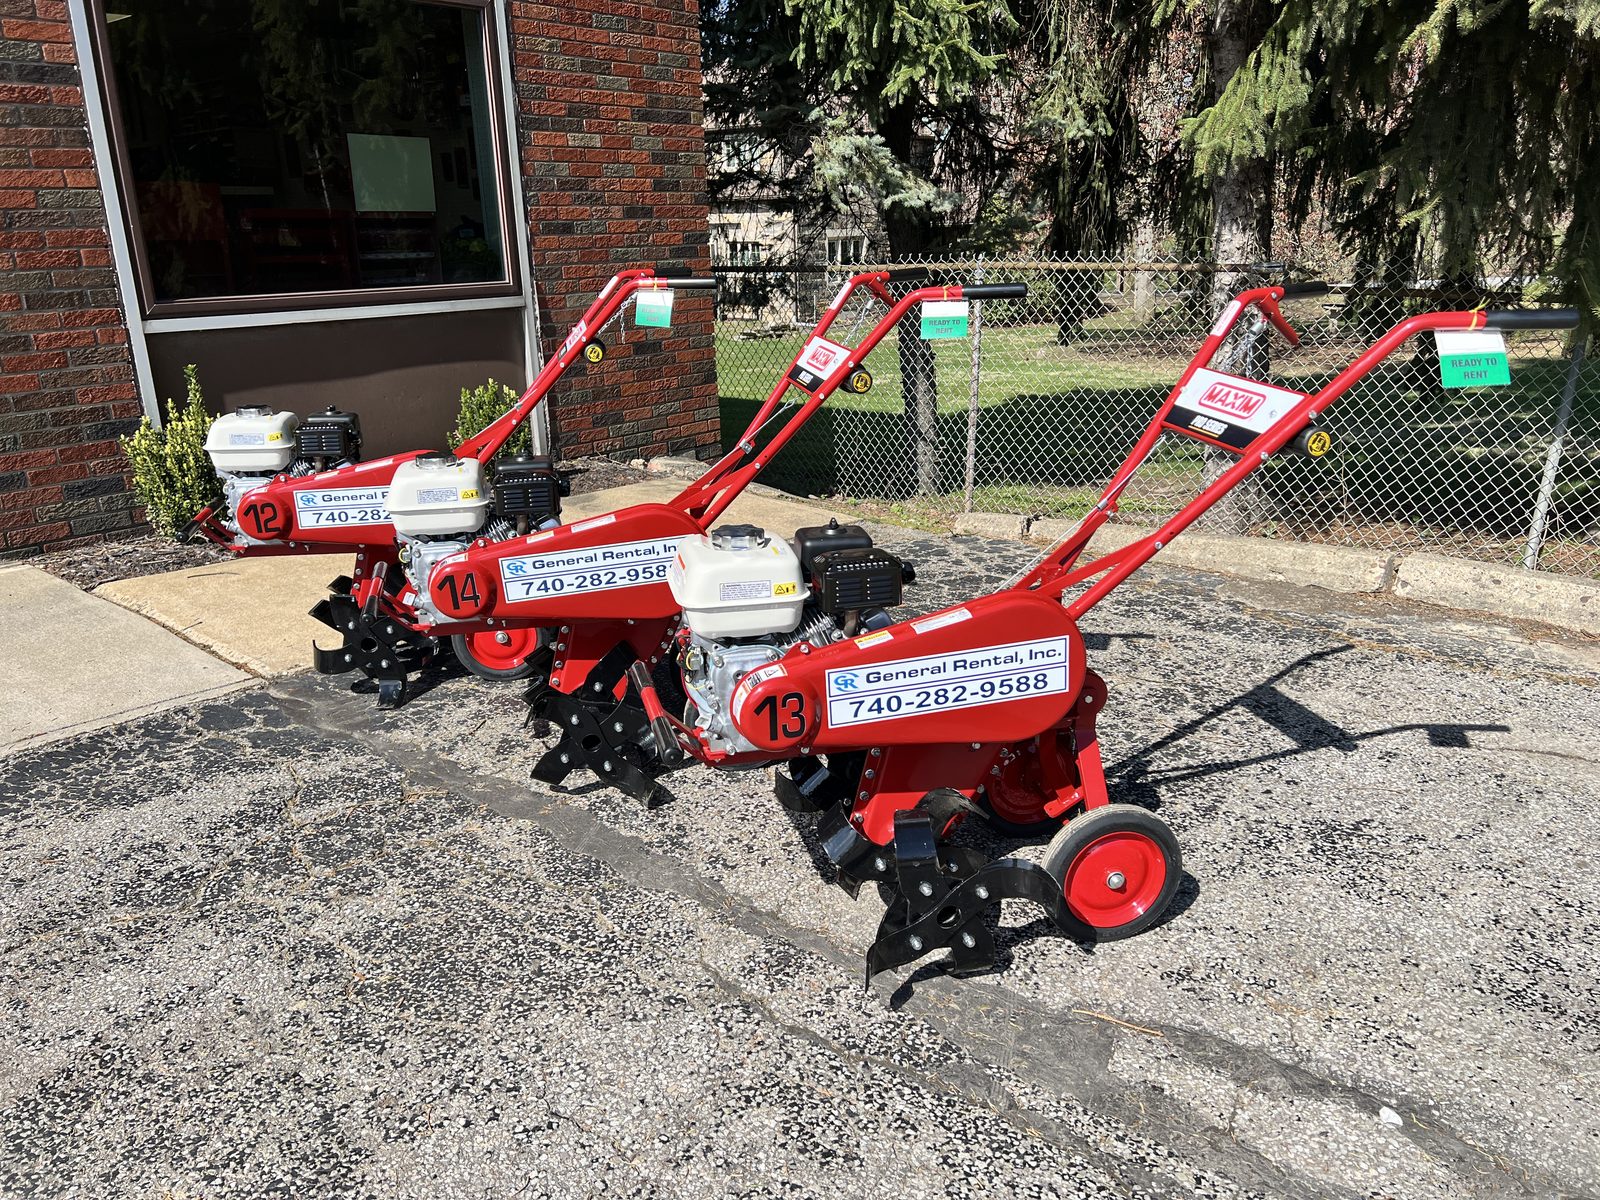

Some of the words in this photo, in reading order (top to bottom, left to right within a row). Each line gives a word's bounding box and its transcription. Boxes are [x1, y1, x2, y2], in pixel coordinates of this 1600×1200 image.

[1451, 358, 1482, 368] READY
[1485, 357, 1498, 366] TO
[1463, 370, 1489, 380] RENT
[1203, 385, 1261, 415] MAXIM
[321, 491, 378, 503] General
[243, 502, 281, 534] 12
[532, 552, 598, 570] General
[602, 545, 659, 561] Rental,
[663, 543, 678, 553] In
[437, 572, 481, 610] 14
[521, 564, 673, 596] 740-282-958
[865, 661, 947, 684] General
[953, 651, 1024, 672] Rental,
[1029, 648, 1062, 661] Inc.
[849, 673, 1049, 718] 740-282-9588
[753, 691, 807, 741] 13
